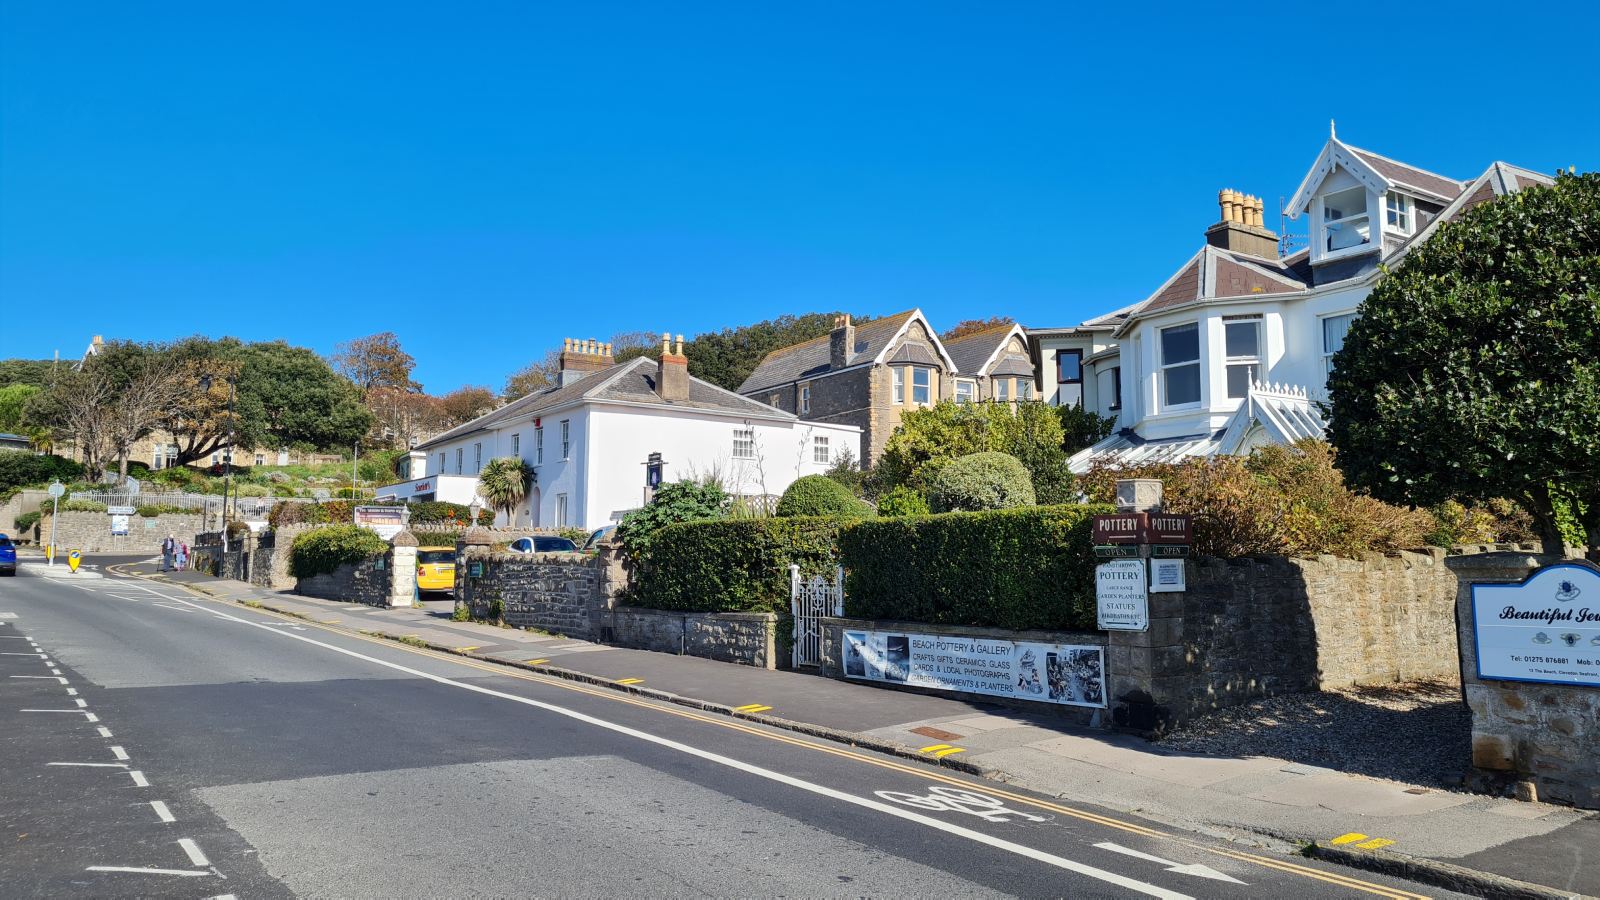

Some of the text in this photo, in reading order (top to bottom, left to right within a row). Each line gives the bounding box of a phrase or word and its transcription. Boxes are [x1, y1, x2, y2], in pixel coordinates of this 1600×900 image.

[1100, 518, 1138, 531] POTTERY
[1152, 518, 1186, 531] POTTERY
[1105, 548, 1127, 556] OPEN
[1100, 571, 1139, 580] POTTERY
[1499, 605, 1573, 624] Beautiful
[912, 640, 1012, 656] BEACH POTTERY & GALLERY
[912, 653, 1010, 670] CRAFTS GIFTS CERAMICS GLASS
[913, 663, 934, 672] CARDS
[943, 666, 962, 675] LOCAL
[964, 667, 1011, 680] PHOTOGRAPHS
[911, 674, 935, 683] GARDEN
[936, 677, 974, 688] ORNAMENTS
[980, 682, 1014, 693] PLANTERS
